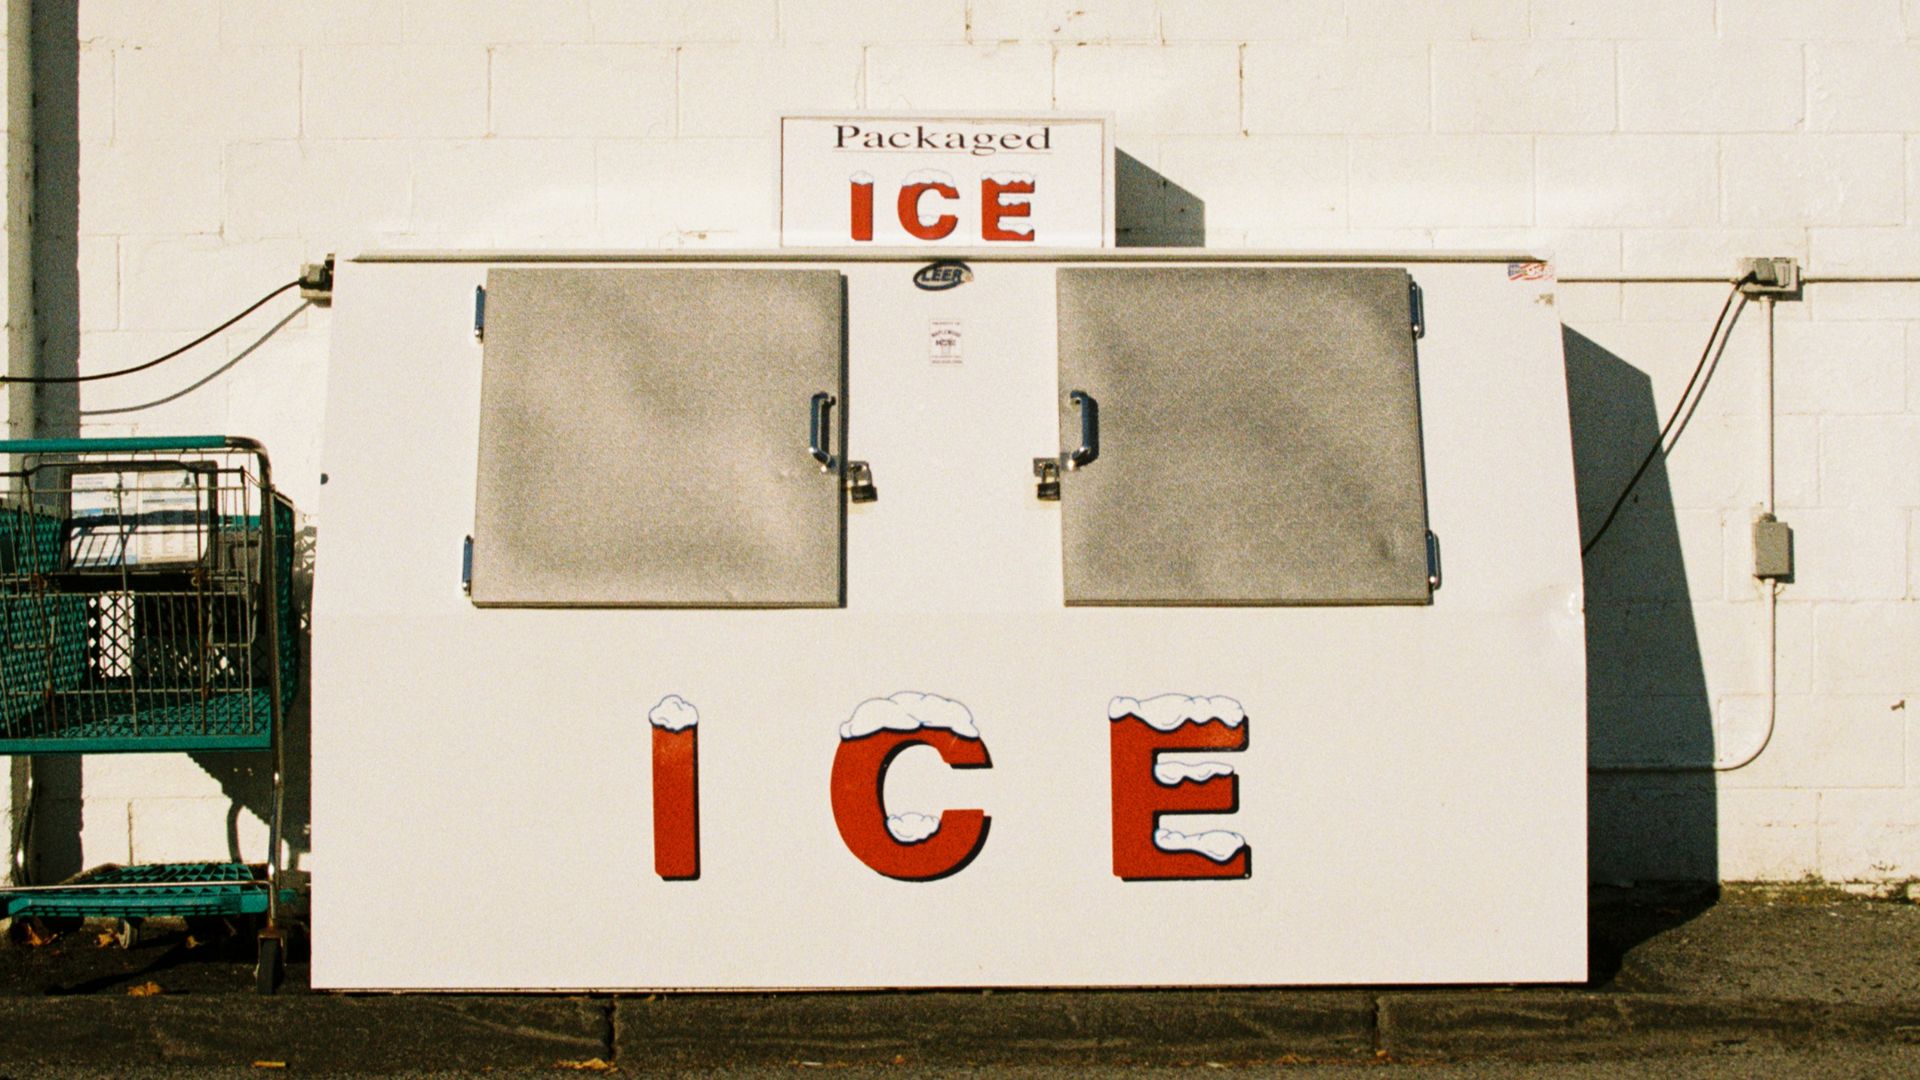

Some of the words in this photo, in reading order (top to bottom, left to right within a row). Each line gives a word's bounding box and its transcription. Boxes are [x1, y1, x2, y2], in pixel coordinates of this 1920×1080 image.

[834, 125, 1051, 156] Packaged
[849, 168, 1036, 241] ICE
[921, 267, 963, 282] LEER
[649, 691, 1252, 882] ICE
